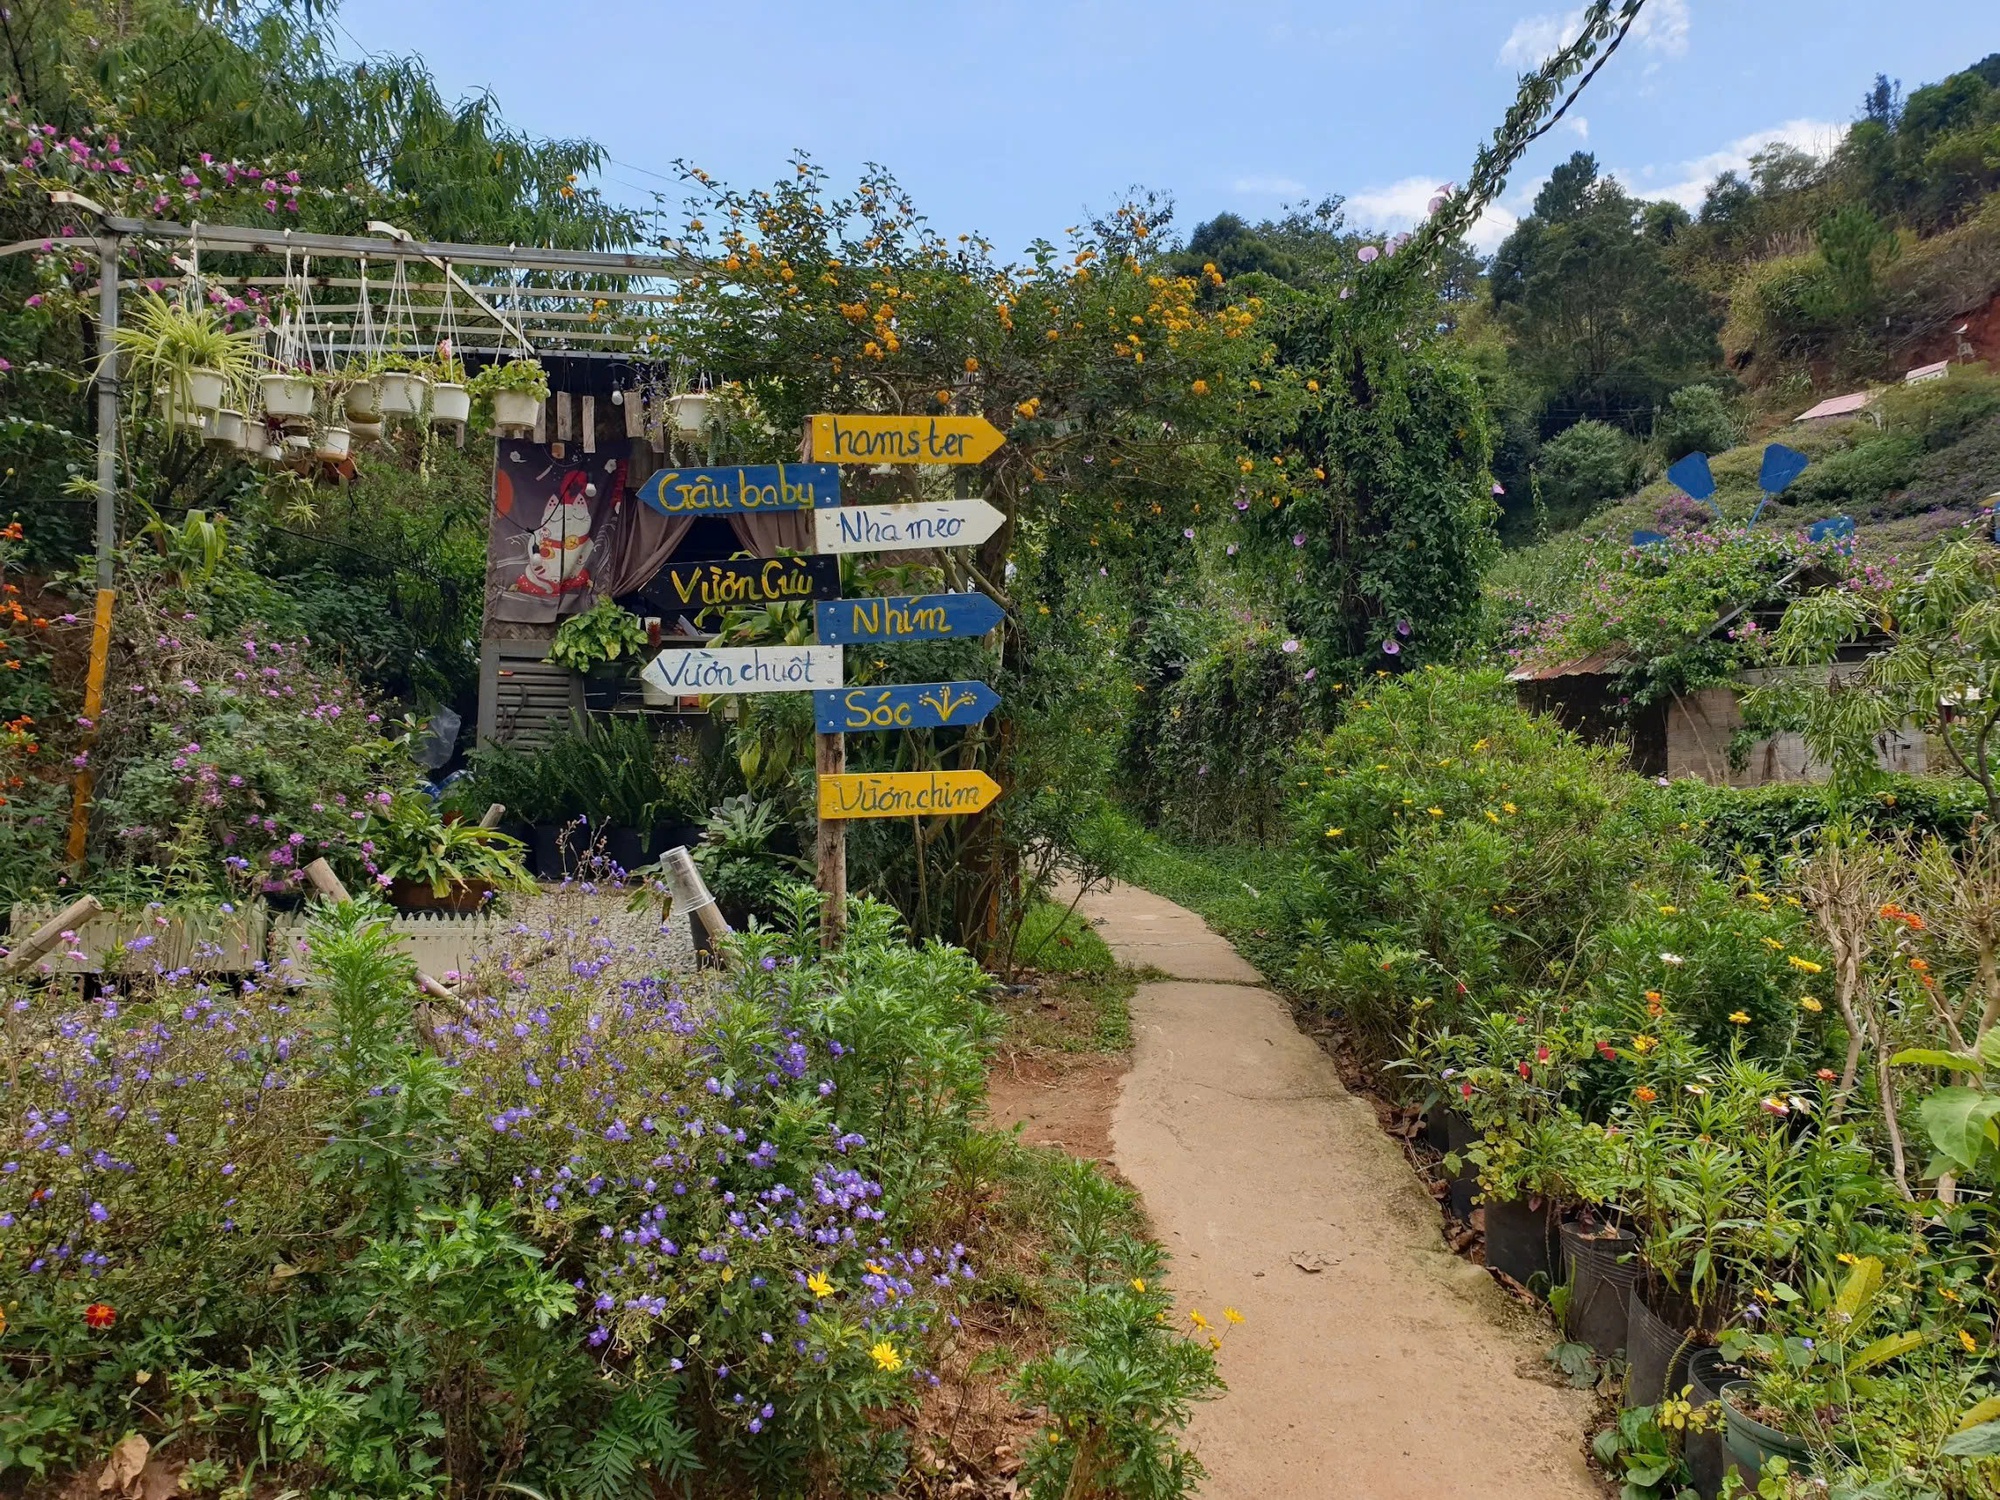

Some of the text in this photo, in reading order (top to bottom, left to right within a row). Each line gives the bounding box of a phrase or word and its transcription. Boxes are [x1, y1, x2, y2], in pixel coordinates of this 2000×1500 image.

[832, 417, 973, 457] hamster
[658, 462, 815, 512] Gâu baby
[839, 508, 962, 544] Nhà mèo
[853, 596, 951, 635] Nhím
[656, 651, 738, 687] Vườn
[844, 691, 912, 728] Sóc
[916, 773, 979, 808] chim
